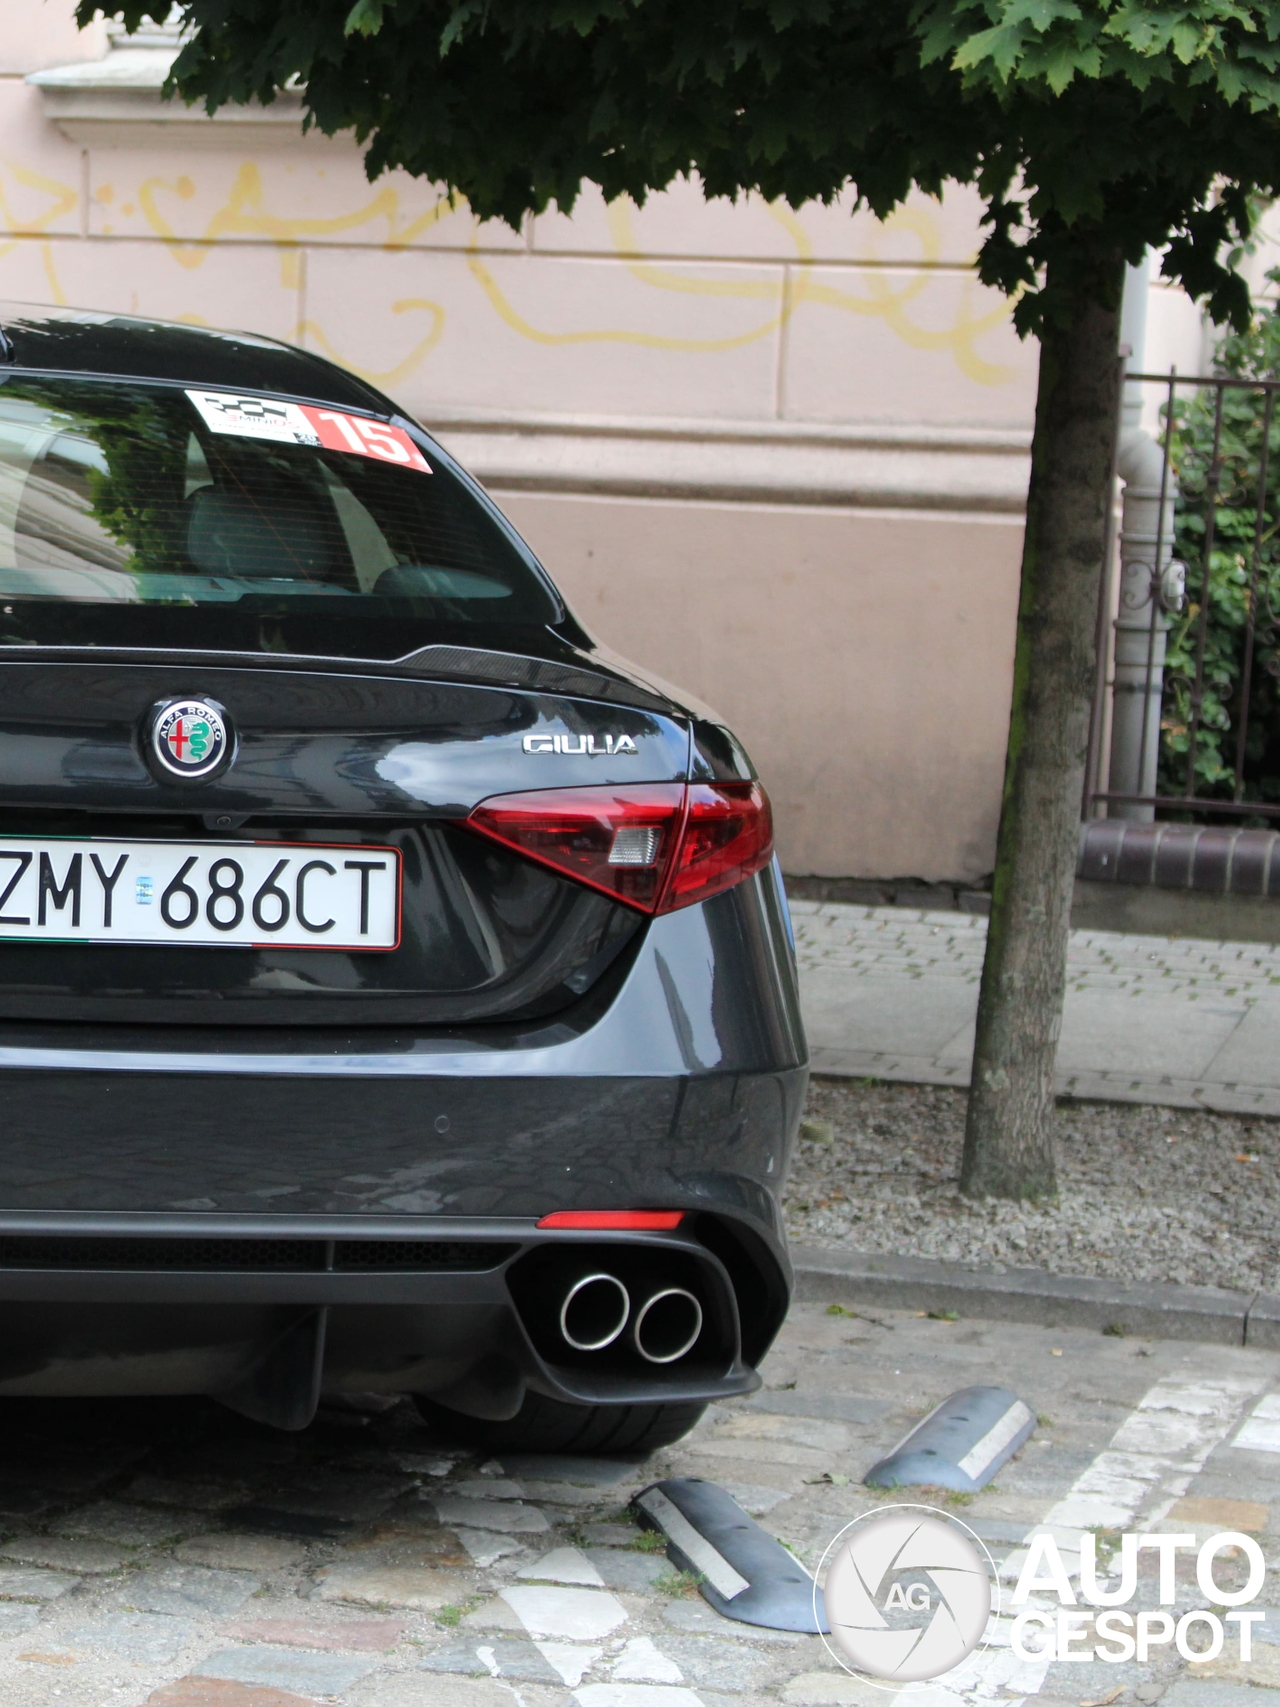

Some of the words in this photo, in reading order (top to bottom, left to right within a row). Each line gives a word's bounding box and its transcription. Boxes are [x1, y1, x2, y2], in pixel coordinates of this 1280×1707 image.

[318, 412, 411, 463] 15
[160, 710, 183, 739] ALFA
[187, 707, 222, 741] ROMEO
[522, 734, 638, 755] GIULIA
[159, 855, 387, 935] 686CT
